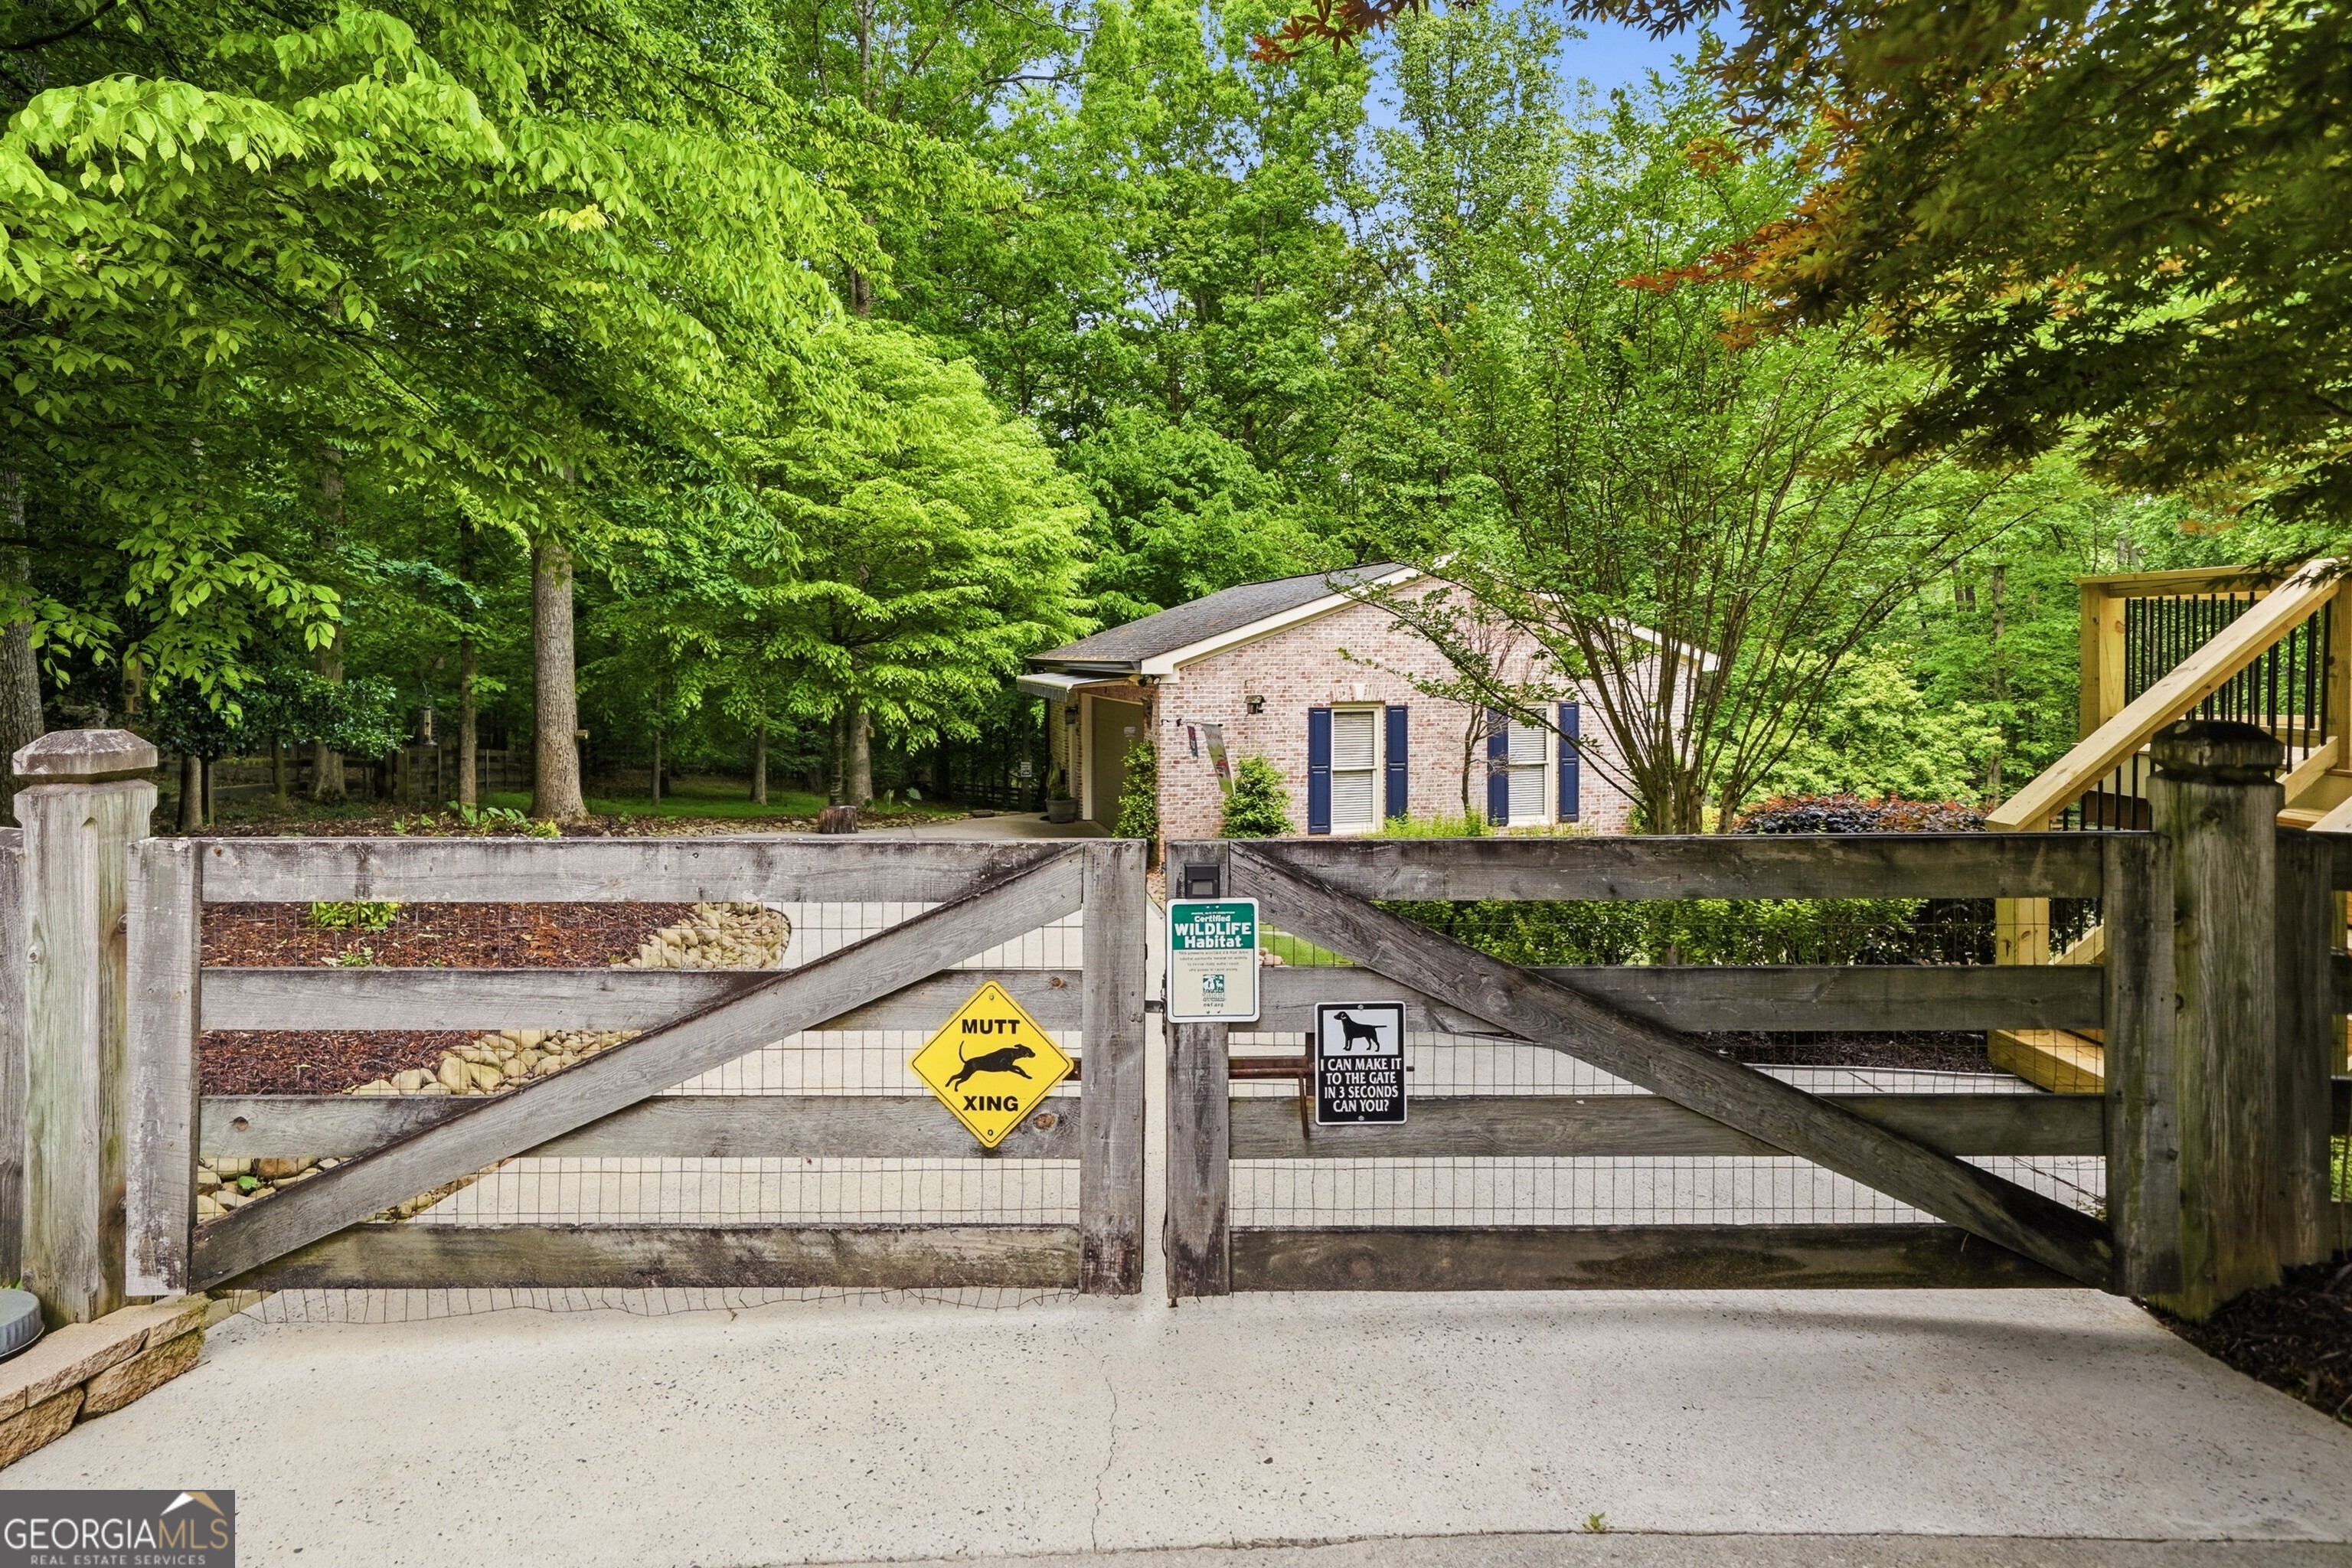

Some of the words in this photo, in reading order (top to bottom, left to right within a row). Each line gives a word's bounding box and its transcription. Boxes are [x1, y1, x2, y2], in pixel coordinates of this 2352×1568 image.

[1174, 922, 1252, 936] WILDLIFE
[1184, 935, 1242, 949] Habitat
[962, 1019, 1021, 1034] MUTT
[1320, 1059, 1325, 1072] I
[1328, 1058, 1352, 1071] CAN
[1354, 1058, 1388, 1071] MAKE
[1391, 1058, 1402, 1070] IT
[1326, 1073, 1342, 1085] TO
[1345, 1072, 1367, 1084] THE
[1369, 1071, 1396, 1084] GATE
[1325, 1086, 1336, 1099] IN
[1339, 1086, 1345, 1099] 3
[1348, 1086, 1399, 1099] SECONDS
[962, 1096, 1019, 1112] XING
[1333, 1099, 1357, 1112] CAN
[1360, 1099, 1390, 1112] YOU?
